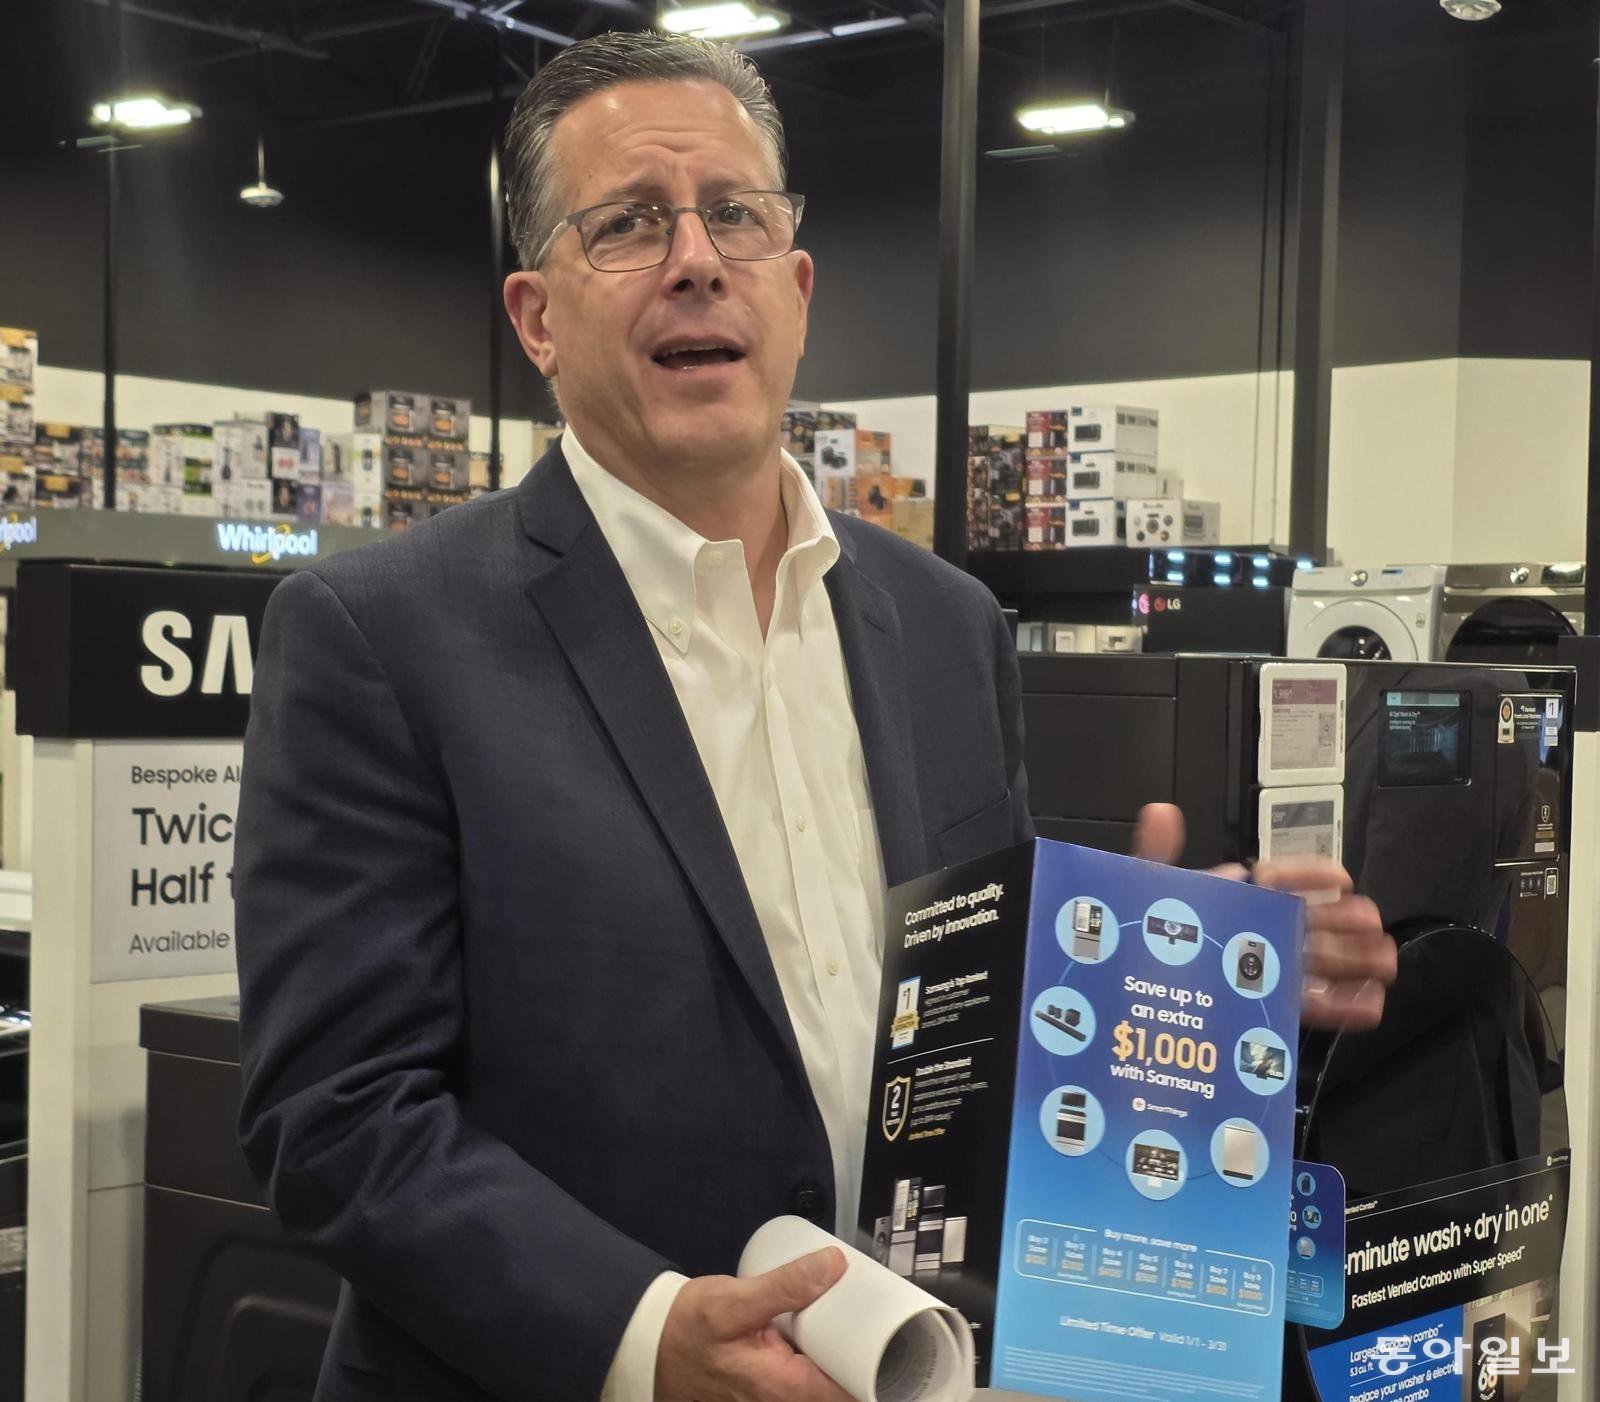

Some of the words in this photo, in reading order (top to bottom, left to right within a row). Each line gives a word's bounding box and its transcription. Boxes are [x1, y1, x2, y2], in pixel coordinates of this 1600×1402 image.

[217, 524, 318, 560] Whirlpool
[1167, 598, 1181, 610] LG
[131, 765, 218, 790] Bespoke
[132, 802, 233, 845] Twic
[131, 861, 215, 906] Half
[904, 896, 955, 926] Committed
[956, 894, 967, 909] to
[967, 883, 1004, 909] quality.
[129, 929, 230, 954] Available
[904, 930, 932, 948] Driven
[932, 924, 945, 942] by
[945, 908, 1000, 935] innovation.
[1124, 975, 1168, 998] Save
[1169, 987, 1193, 1007] up
[1195, 989, 1214, 1008] to
[1131, 1004, 1155, 1020] an
[1157, 1009, 1204, 1030] extra
[1111, 1020, 1217, 1074] $1,000
[892, 1085, 902, 1109] 2
[1109, 1064, 1145, 1081] with
[1146, 1069, 1216, 1100] Samsung
[1103, 1229, 1121, 1242] Buy
[1149, 1238, 1172, 1249] save
[1172, 1242, 1198, 1253] more
[1413, 1221, 1461, 1257] wash
[1464, 1223, 1472, 1237] +
[1474, 1212, 1502, 1244] dry
[1505, 1204, 1518, 1231] in
[1351, 1285, 1386, 1309] Fastest
[1387, 1277, 1418, 1299] Vented
[1419, 1270, 1452, 1289] Combo
[1453, 1263, 1472, 1280] with
[1472, 1256, 1496, 1276] Super
[1059, 1315, 1099, 1331] Limited
[1100, 1321, 1126, 1335] Time
[1127, 1326, 1155, 1340] Offer
[1158, 1331, 1184, 1345] Valid
[1350, 1344, 1380, 1363] Largest
[1380, 1383, 1398, 1400] your
[1398, 1372, 1426, 1391] washer
[1425, 1369, 1433, 1382] &
